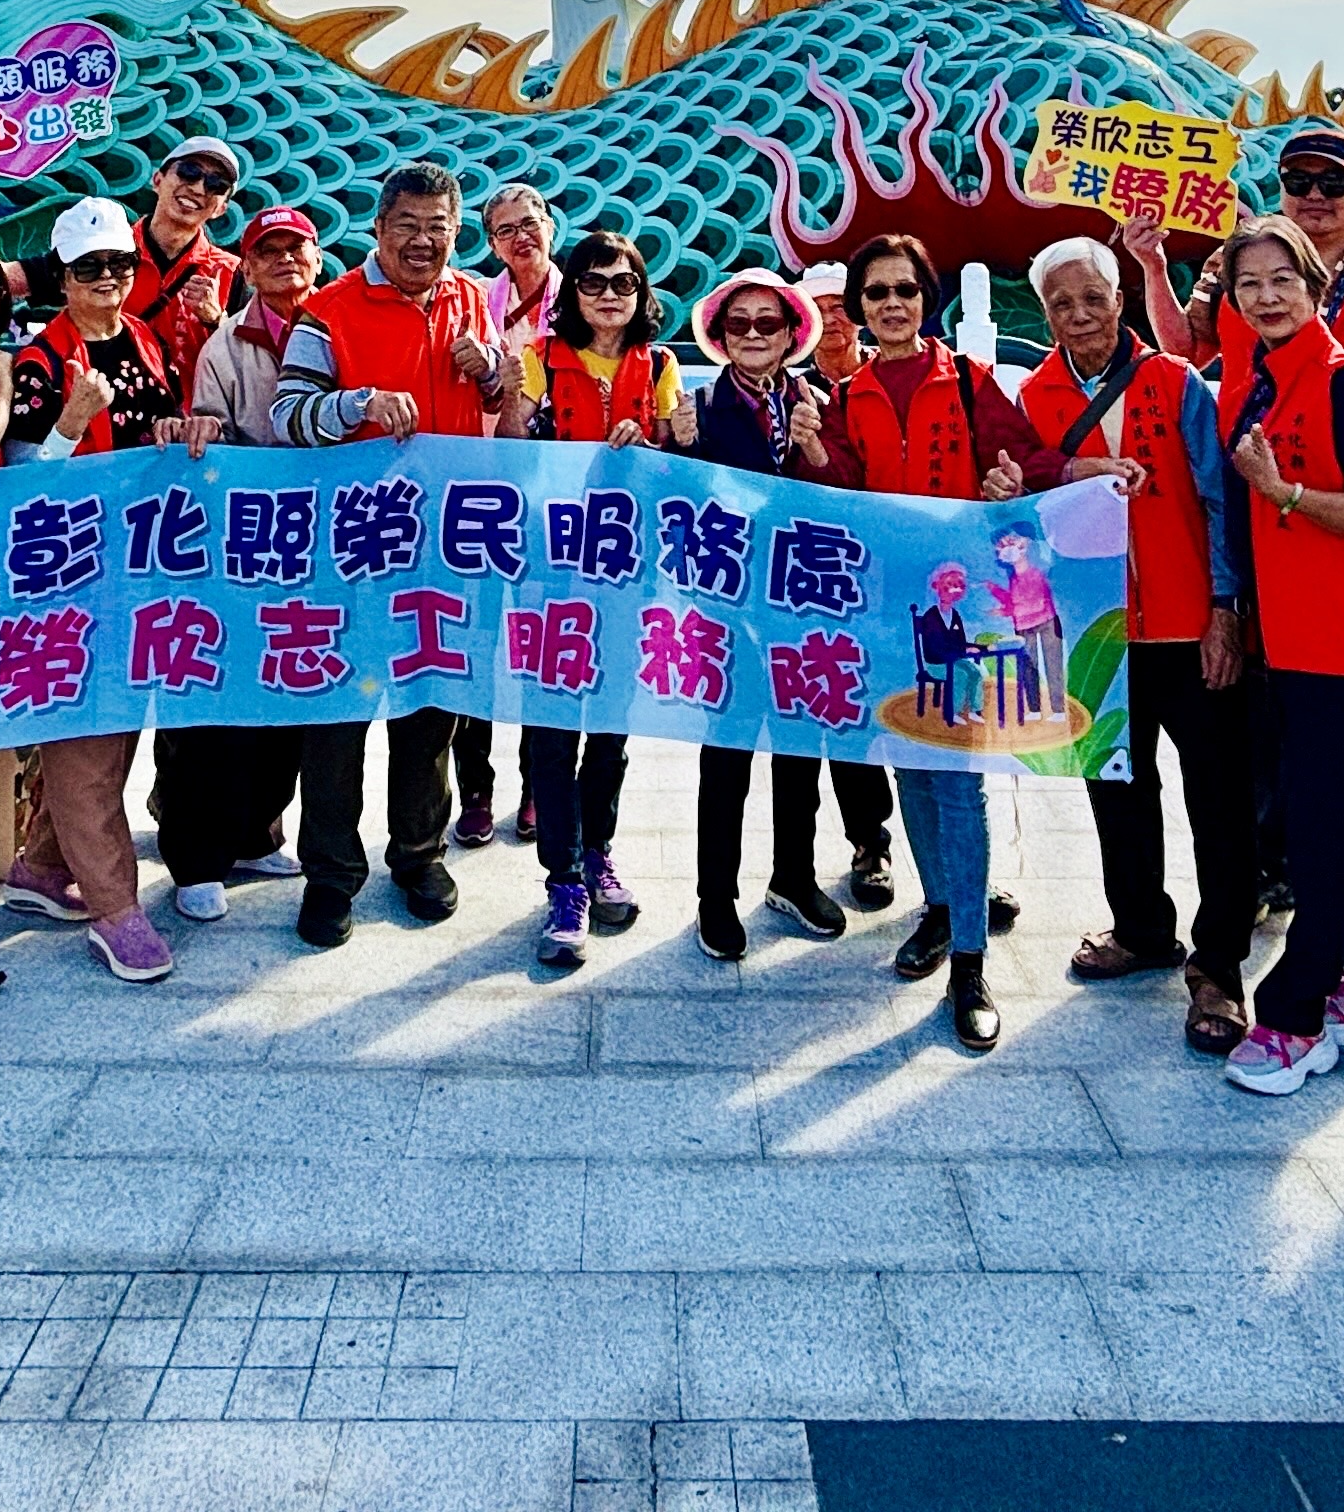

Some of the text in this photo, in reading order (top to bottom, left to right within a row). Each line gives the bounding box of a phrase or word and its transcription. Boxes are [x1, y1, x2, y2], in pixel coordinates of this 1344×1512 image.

[1052, 110, 1221, 165] 榮欣志工
[1069, 161, 1235, 232] 我驕傲
[6, 478, 866, 615] 彰化縣榮民服務處
